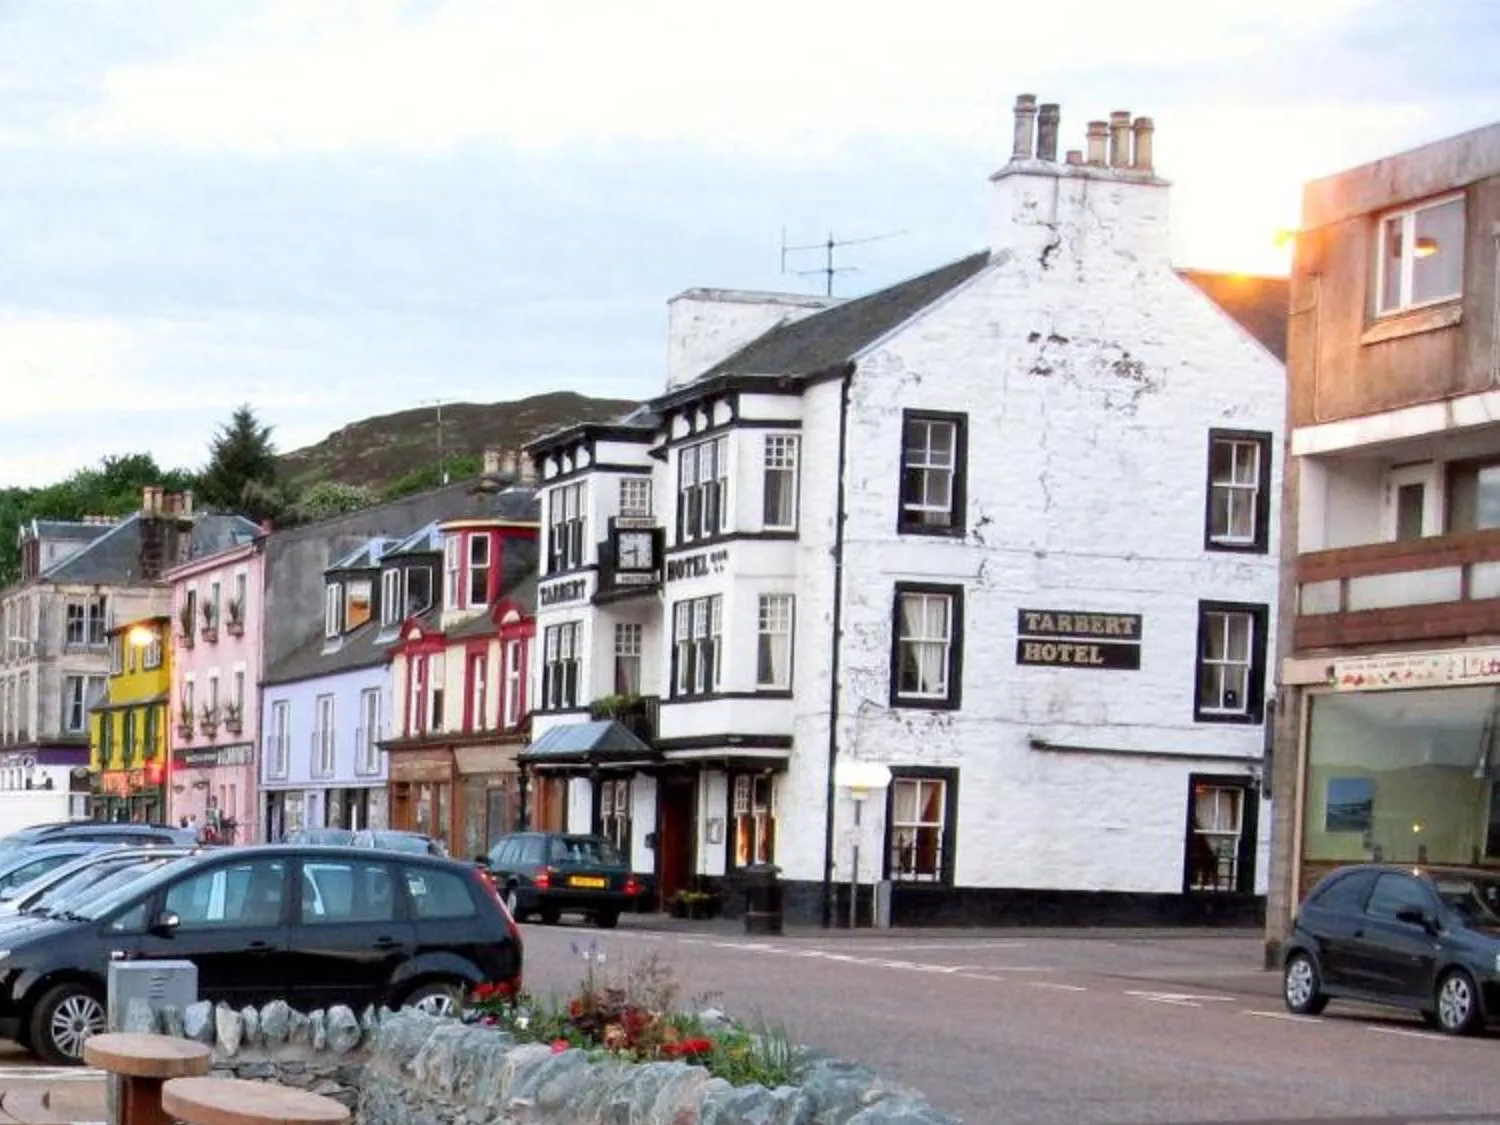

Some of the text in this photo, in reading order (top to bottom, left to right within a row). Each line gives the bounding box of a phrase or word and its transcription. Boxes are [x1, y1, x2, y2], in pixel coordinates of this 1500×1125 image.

[668, 554, 709, 581] HOTEL
[1025, 612, 1136, 635] TARBERT
[1023, 642, 1104, 665] HOTEL
